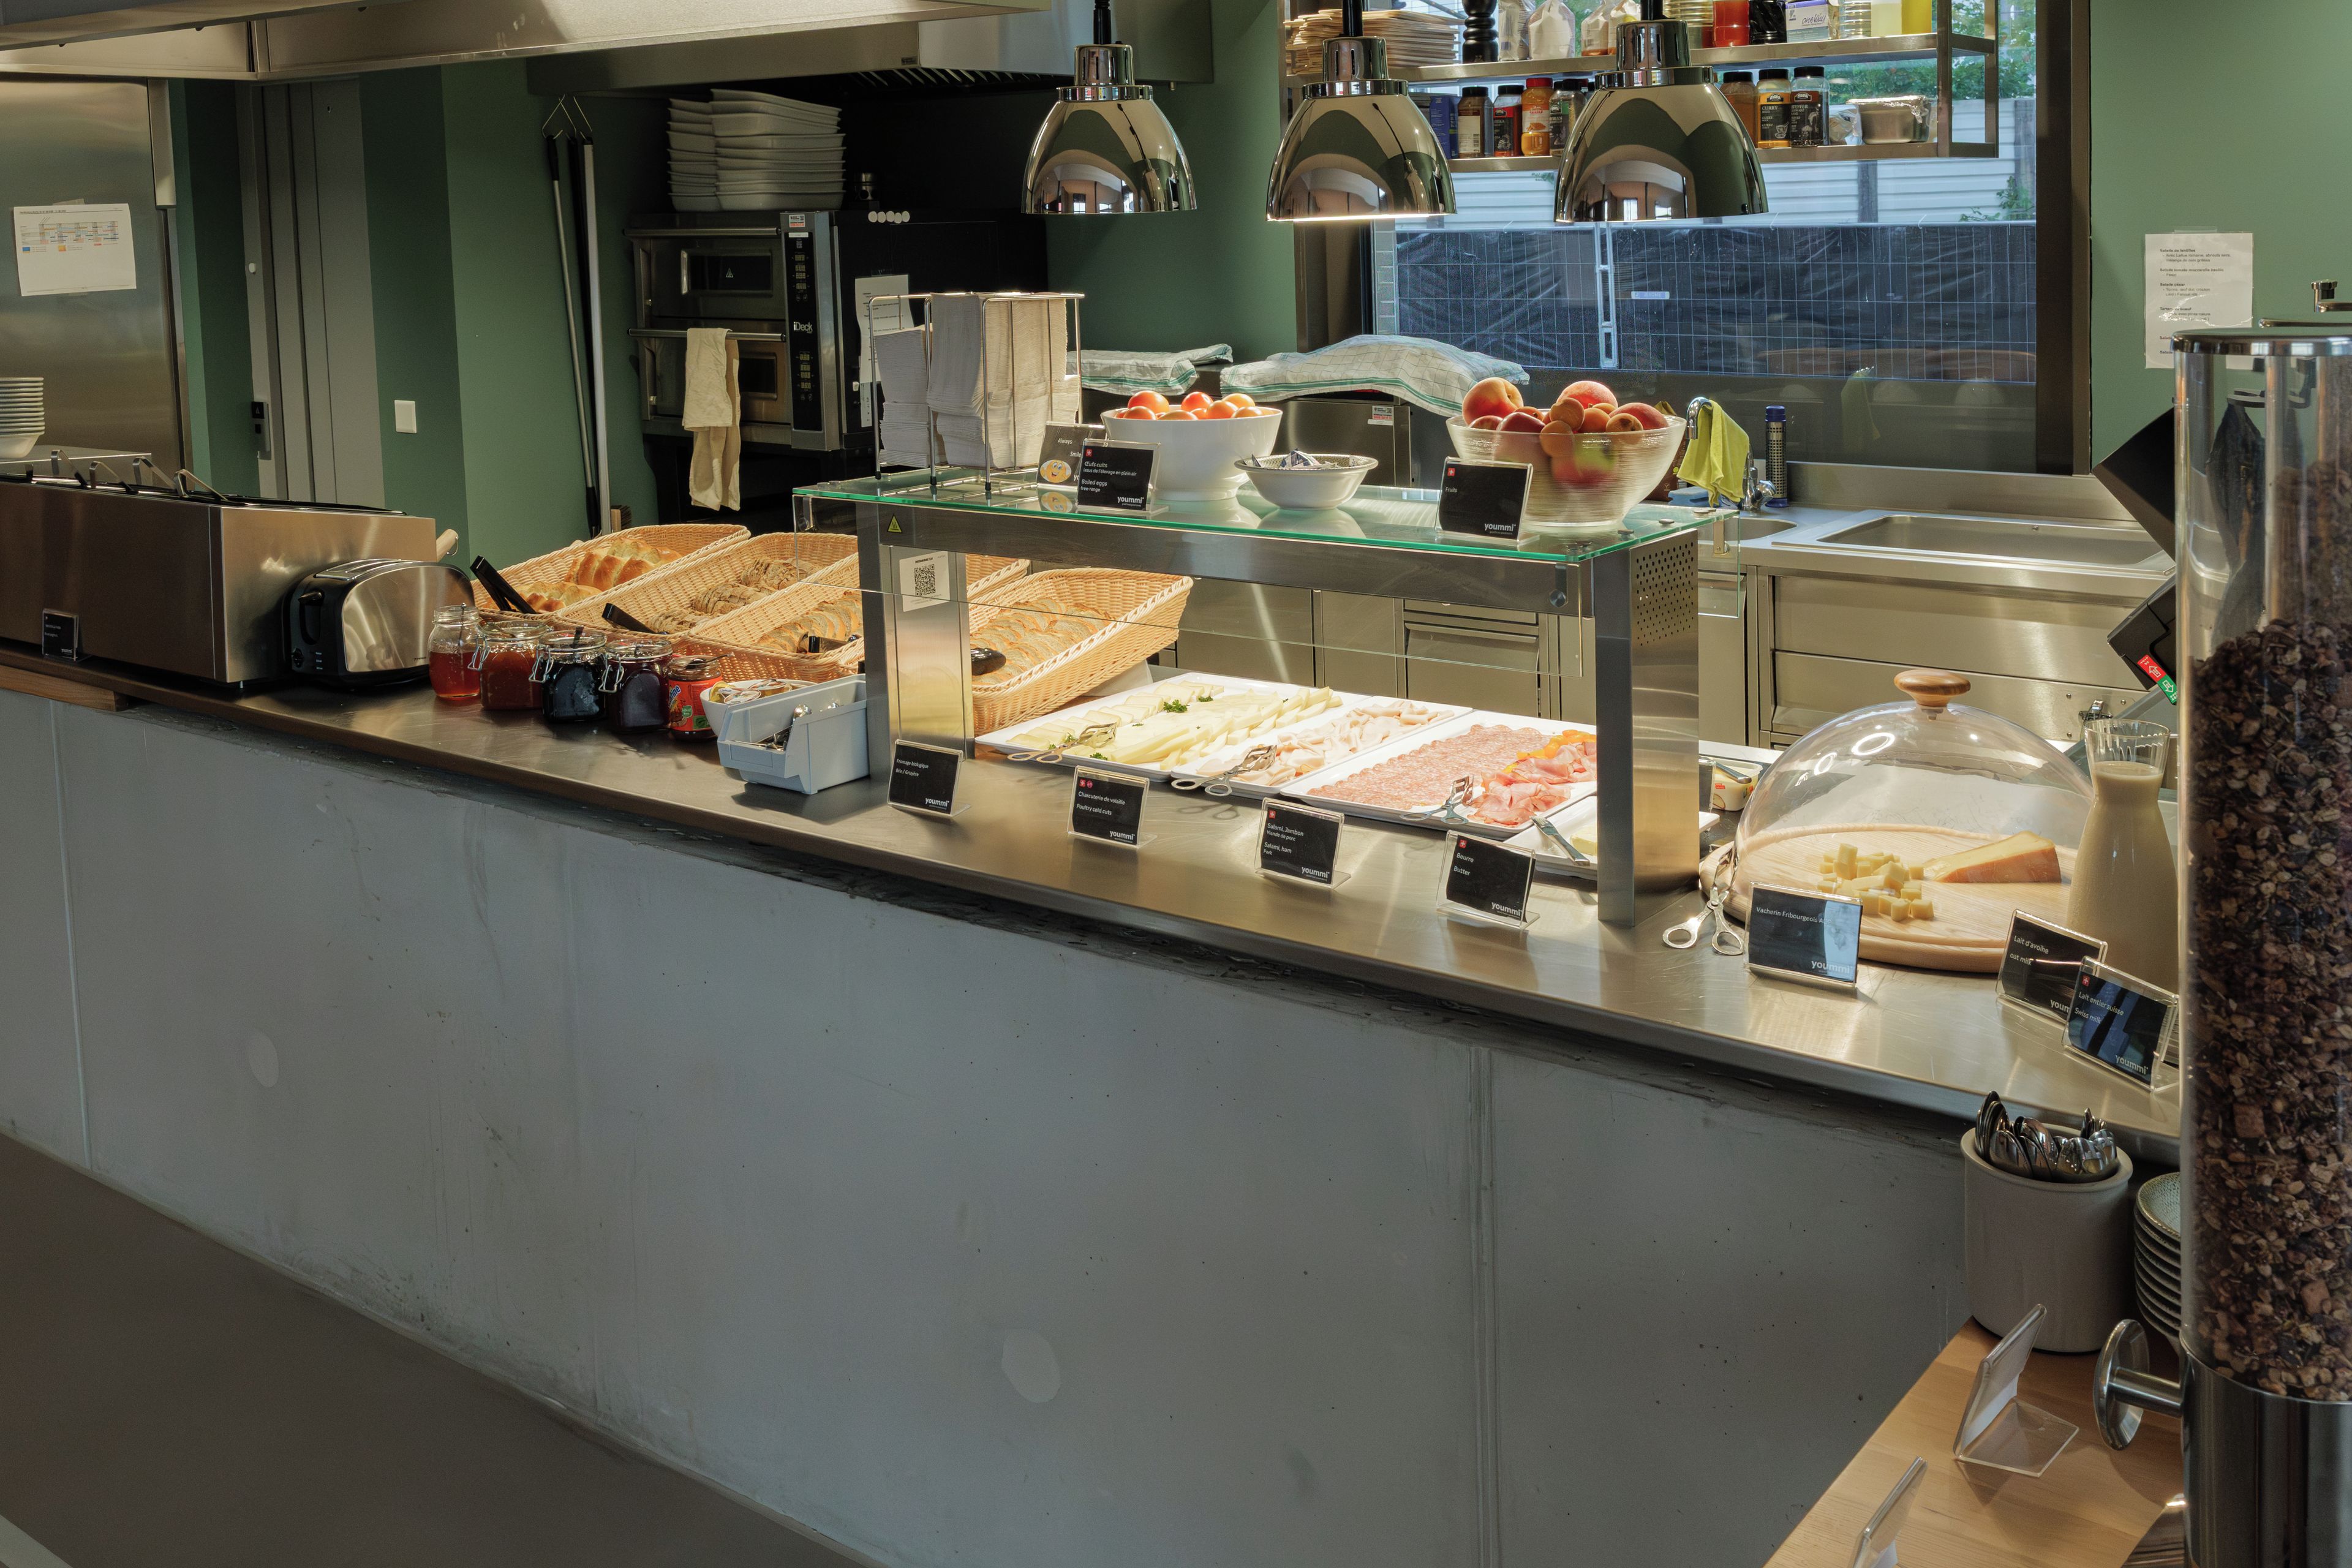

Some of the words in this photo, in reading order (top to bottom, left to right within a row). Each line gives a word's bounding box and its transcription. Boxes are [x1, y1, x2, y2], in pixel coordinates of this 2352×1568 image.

[793, 322, 813, 331] iDeck
[1484, 522, 1515, 532] yoummi
[1078, 791, 1103, 801] Charcuterie
[925, 797, 948, 807] yoummi
[1076, 803, 1093, 812] Poultry
[1109, 831, 1134, 840] yoummi
[1267, 823, 1284, 832] Salami,
[1284, 827, 1304, 837] Jambon
[1264, 842, 1281, 852] Salami,
[1281, 845, 1292, 854] ham
[1456, 852, 1474, 863] Beurre
[1302, 866, 1329, 878] yoummi
[1453, 865, 1471, 876] Butter
[1491, 902, 1521, 917] yoummi
[1755, 907, 1781, 917] Vacherin
[1782, 911, 1818, 922] Fribourgeois
[2014, 935, 2025, 945] Lait
[1811, 960, 1850, 974] yoummi
[2020, 957, 2032, 966] milk
[2079, 991, 2089, 1001] Lait
[2090, 997, 2106, 1008] entier
[2106, 1003, 2124, 1016] suisse
[2074, 1007, 2089, 1019] Swiss
[2089, 1014, 2102, 1024] milk
[2115, 1055, 2147, 1075] yoummi
